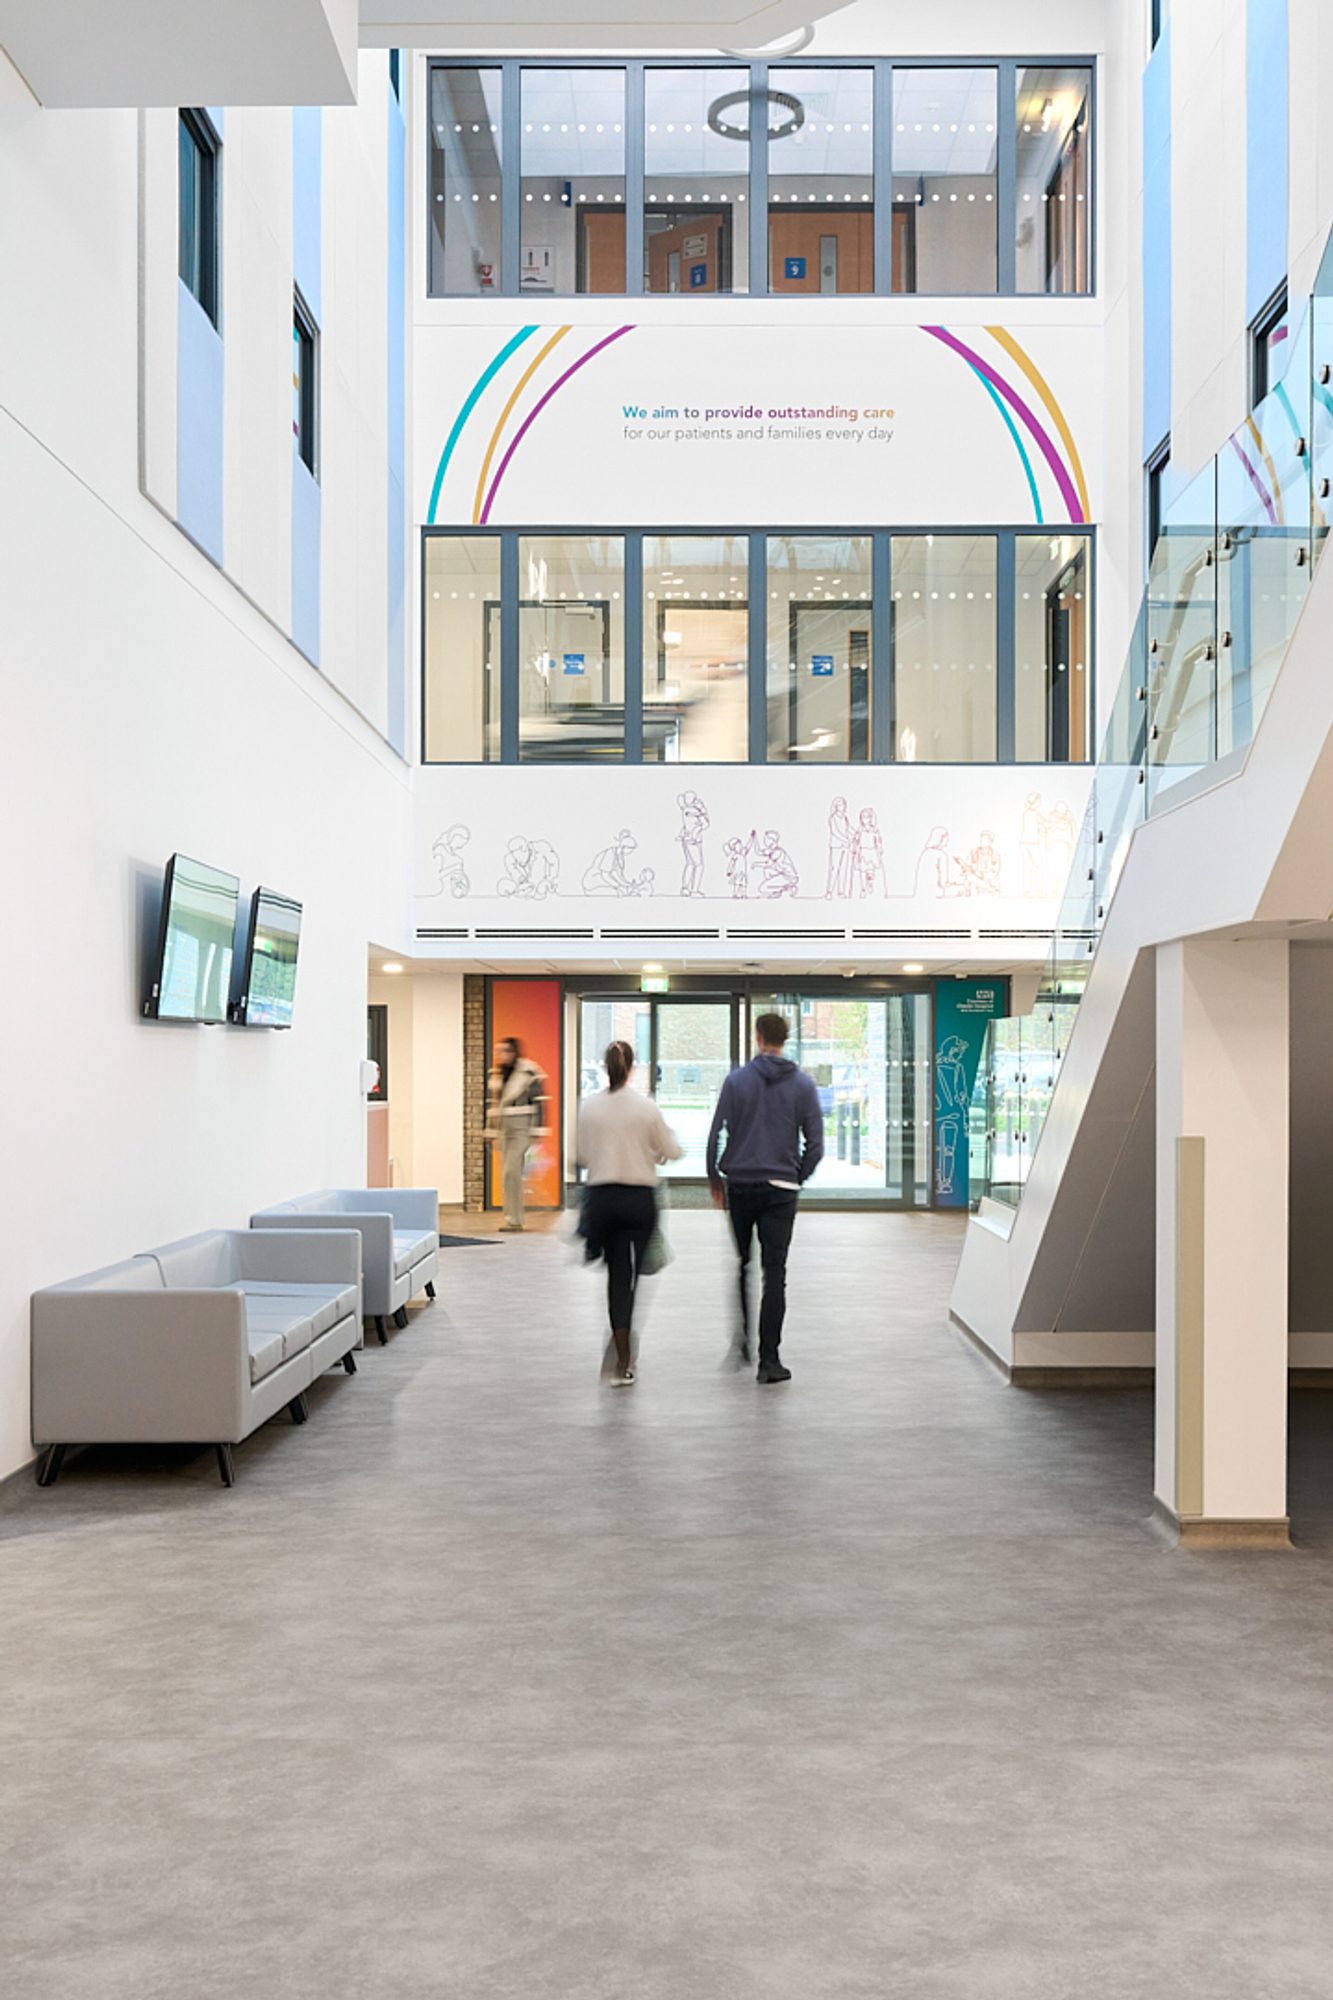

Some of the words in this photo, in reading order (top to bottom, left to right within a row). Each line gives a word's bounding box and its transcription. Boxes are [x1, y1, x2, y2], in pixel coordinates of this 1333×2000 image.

[622, 405, 648, 419] We
[652, 405, 679, 419] aim
[683, 407, 700, 419] to
[705, 405, 763, 422] provide
[768, 405, 859, 422] outstanding
[863, 408, 895, 419] care
[623, 426, 643, 440] for
[647, 429, 671, 440] our
[675, 426, 733, 442] patients
[736, 426, 764, 440] and
[768, 426, 822, 440] families
[825, 429, 864, 443] every
[867, 426, 894, 443] day
